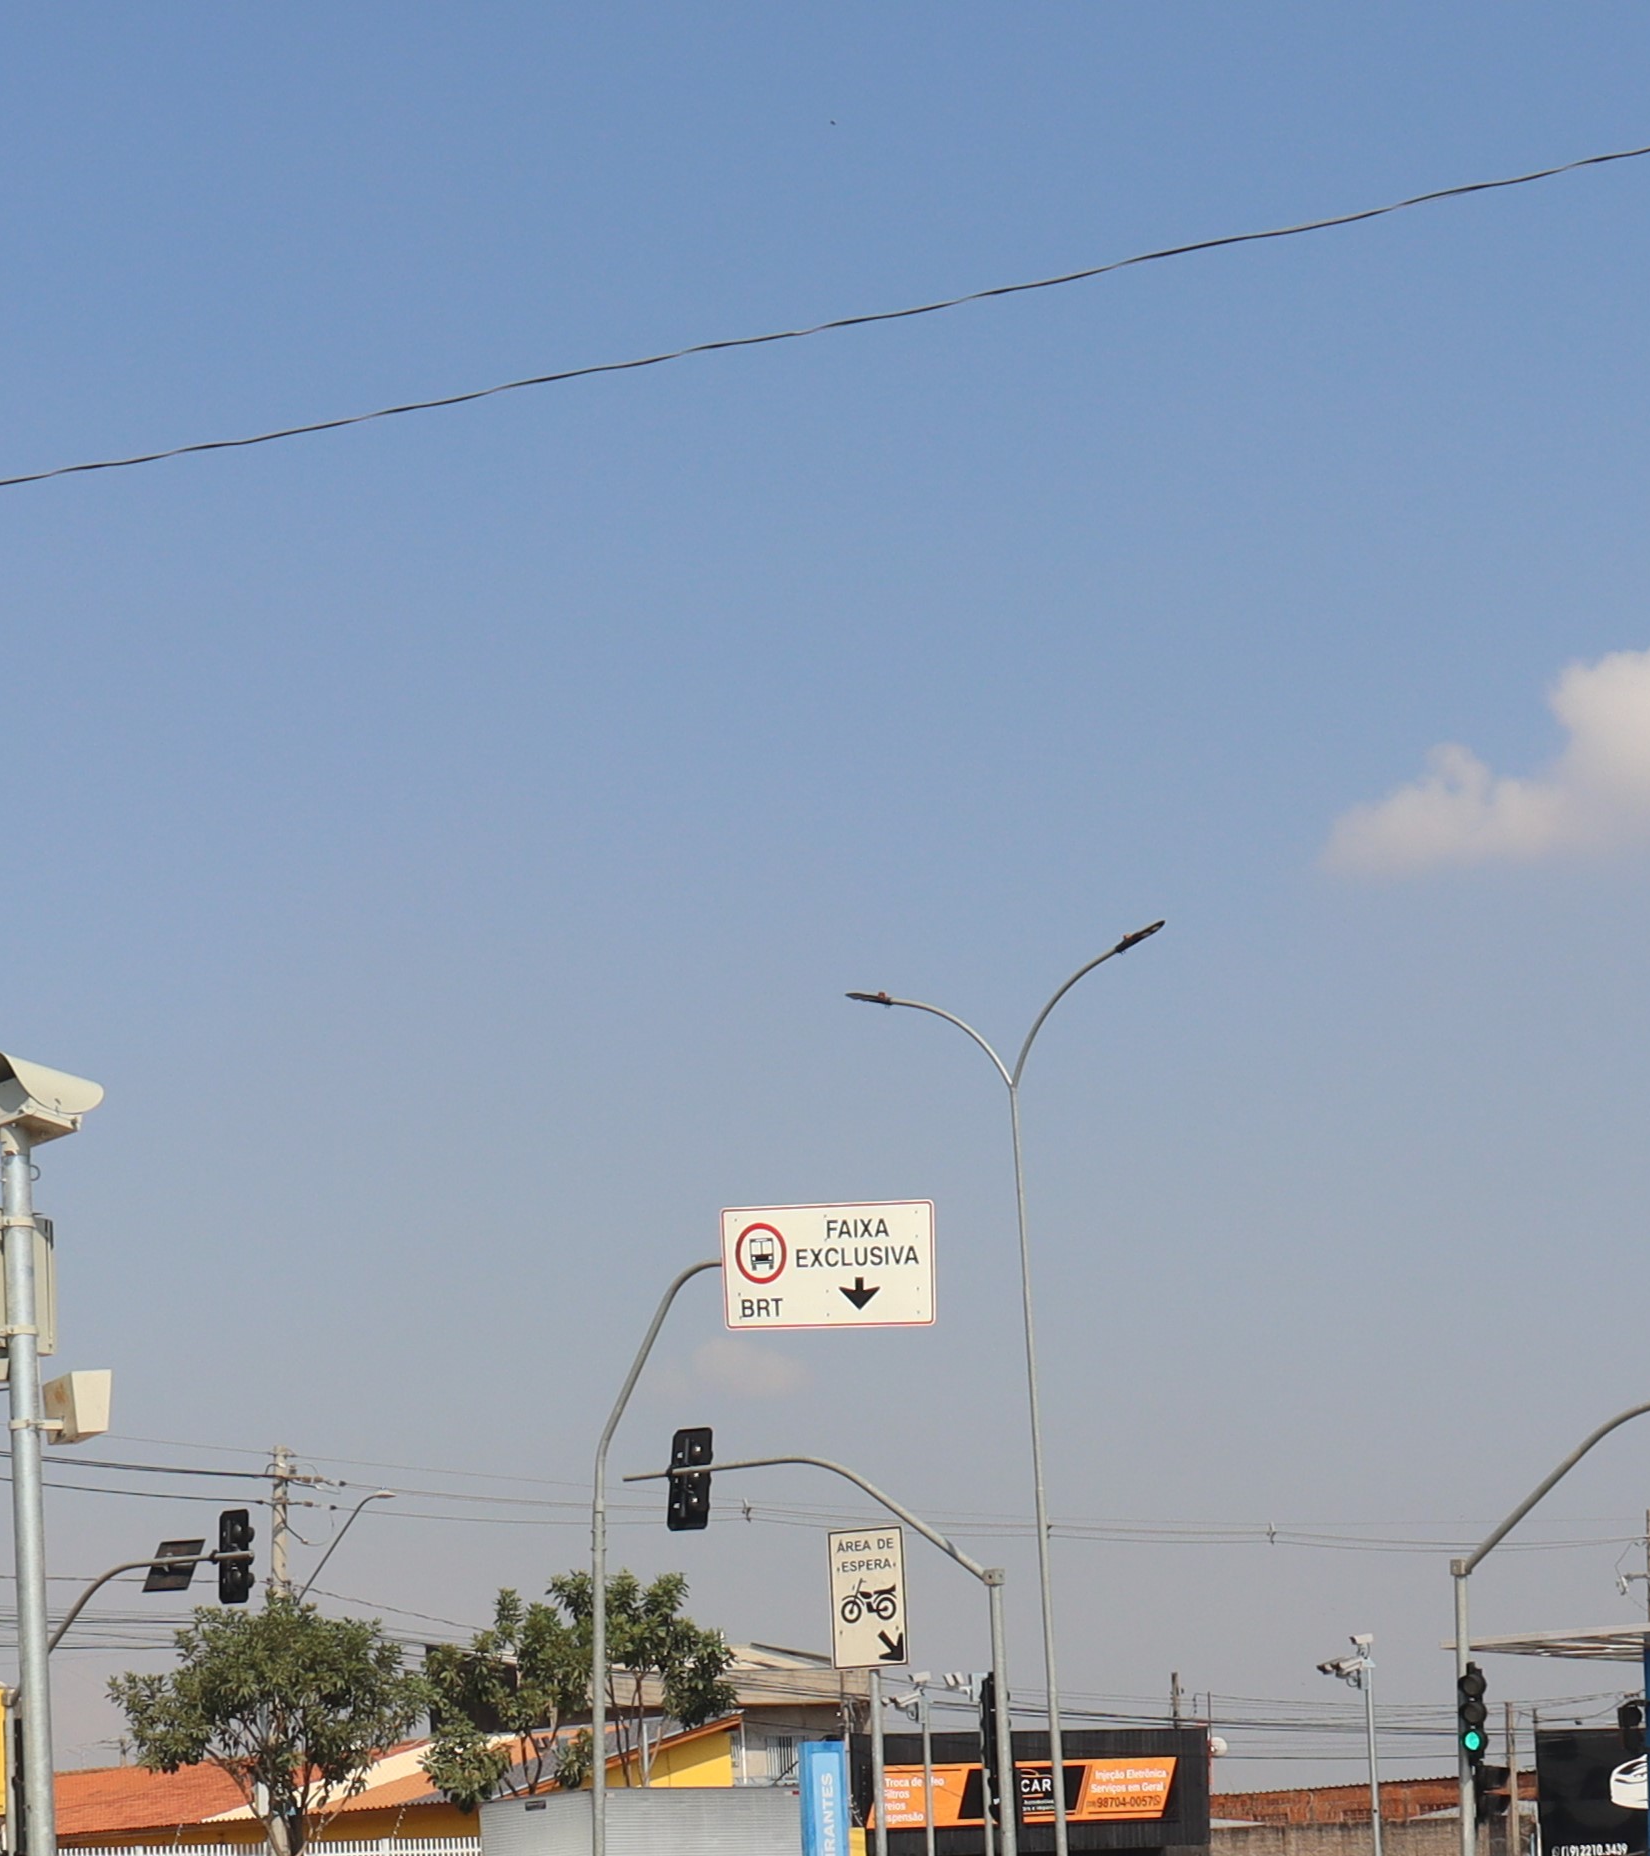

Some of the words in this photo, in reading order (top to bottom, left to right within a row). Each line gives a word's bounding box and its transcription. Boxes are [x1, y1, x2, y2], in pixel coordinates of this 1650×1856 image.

[825, 1218, 890, 1239] FAIXA
[795, 1246, 920, 1268] EXCLUSIVA
[741, 1298, 783, 1318] BRT
[837, 1540, 872, 1553] ÁREA
[876, 1538, 895, 1550] DE
[841, 1558, 892, 1573] ESPERA
[884, 1778, 910, 1787] Troca
[911, 1777, 923, 1787] de
[1020, 1779, 1052, 1793] CAR
[1128, 1784, 1141, 1792] em
[1142, 1782, 1165, 1792] Geral
